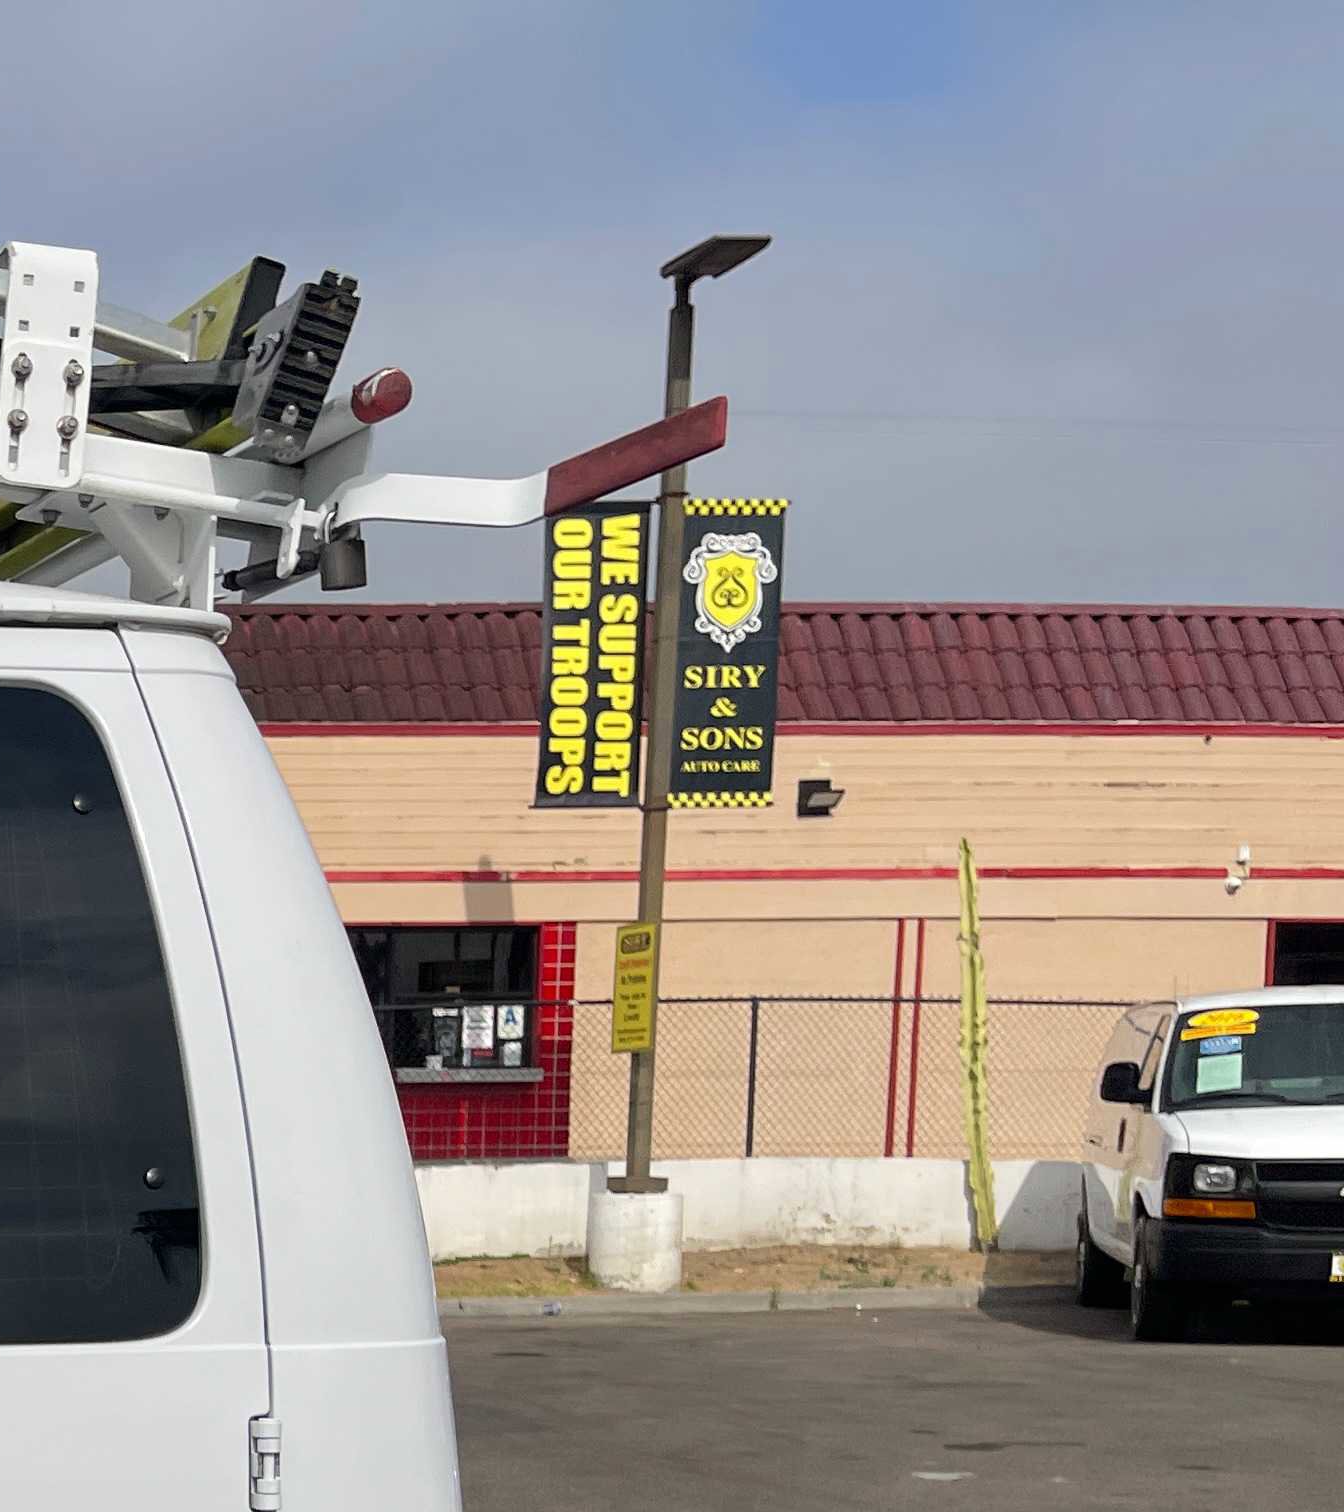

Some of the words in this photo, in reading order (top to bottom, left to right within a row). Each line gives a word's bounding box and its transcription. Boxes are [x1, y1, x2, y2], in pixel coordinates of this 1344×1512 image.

[552, 517, 594, 610] OUR
[600, 513, 641, 585] WE
[592, 593, 638, 798] SUPPORT
[683, 664, 767, 689] SIRY
[545, 618, 591, 795] TROOPS
[710, 697, 737, 718] &
[679, 727, 763, 751] SONS
[680, 760, 720, 773] AUTO
[721, 759, 760, 773] CARE
